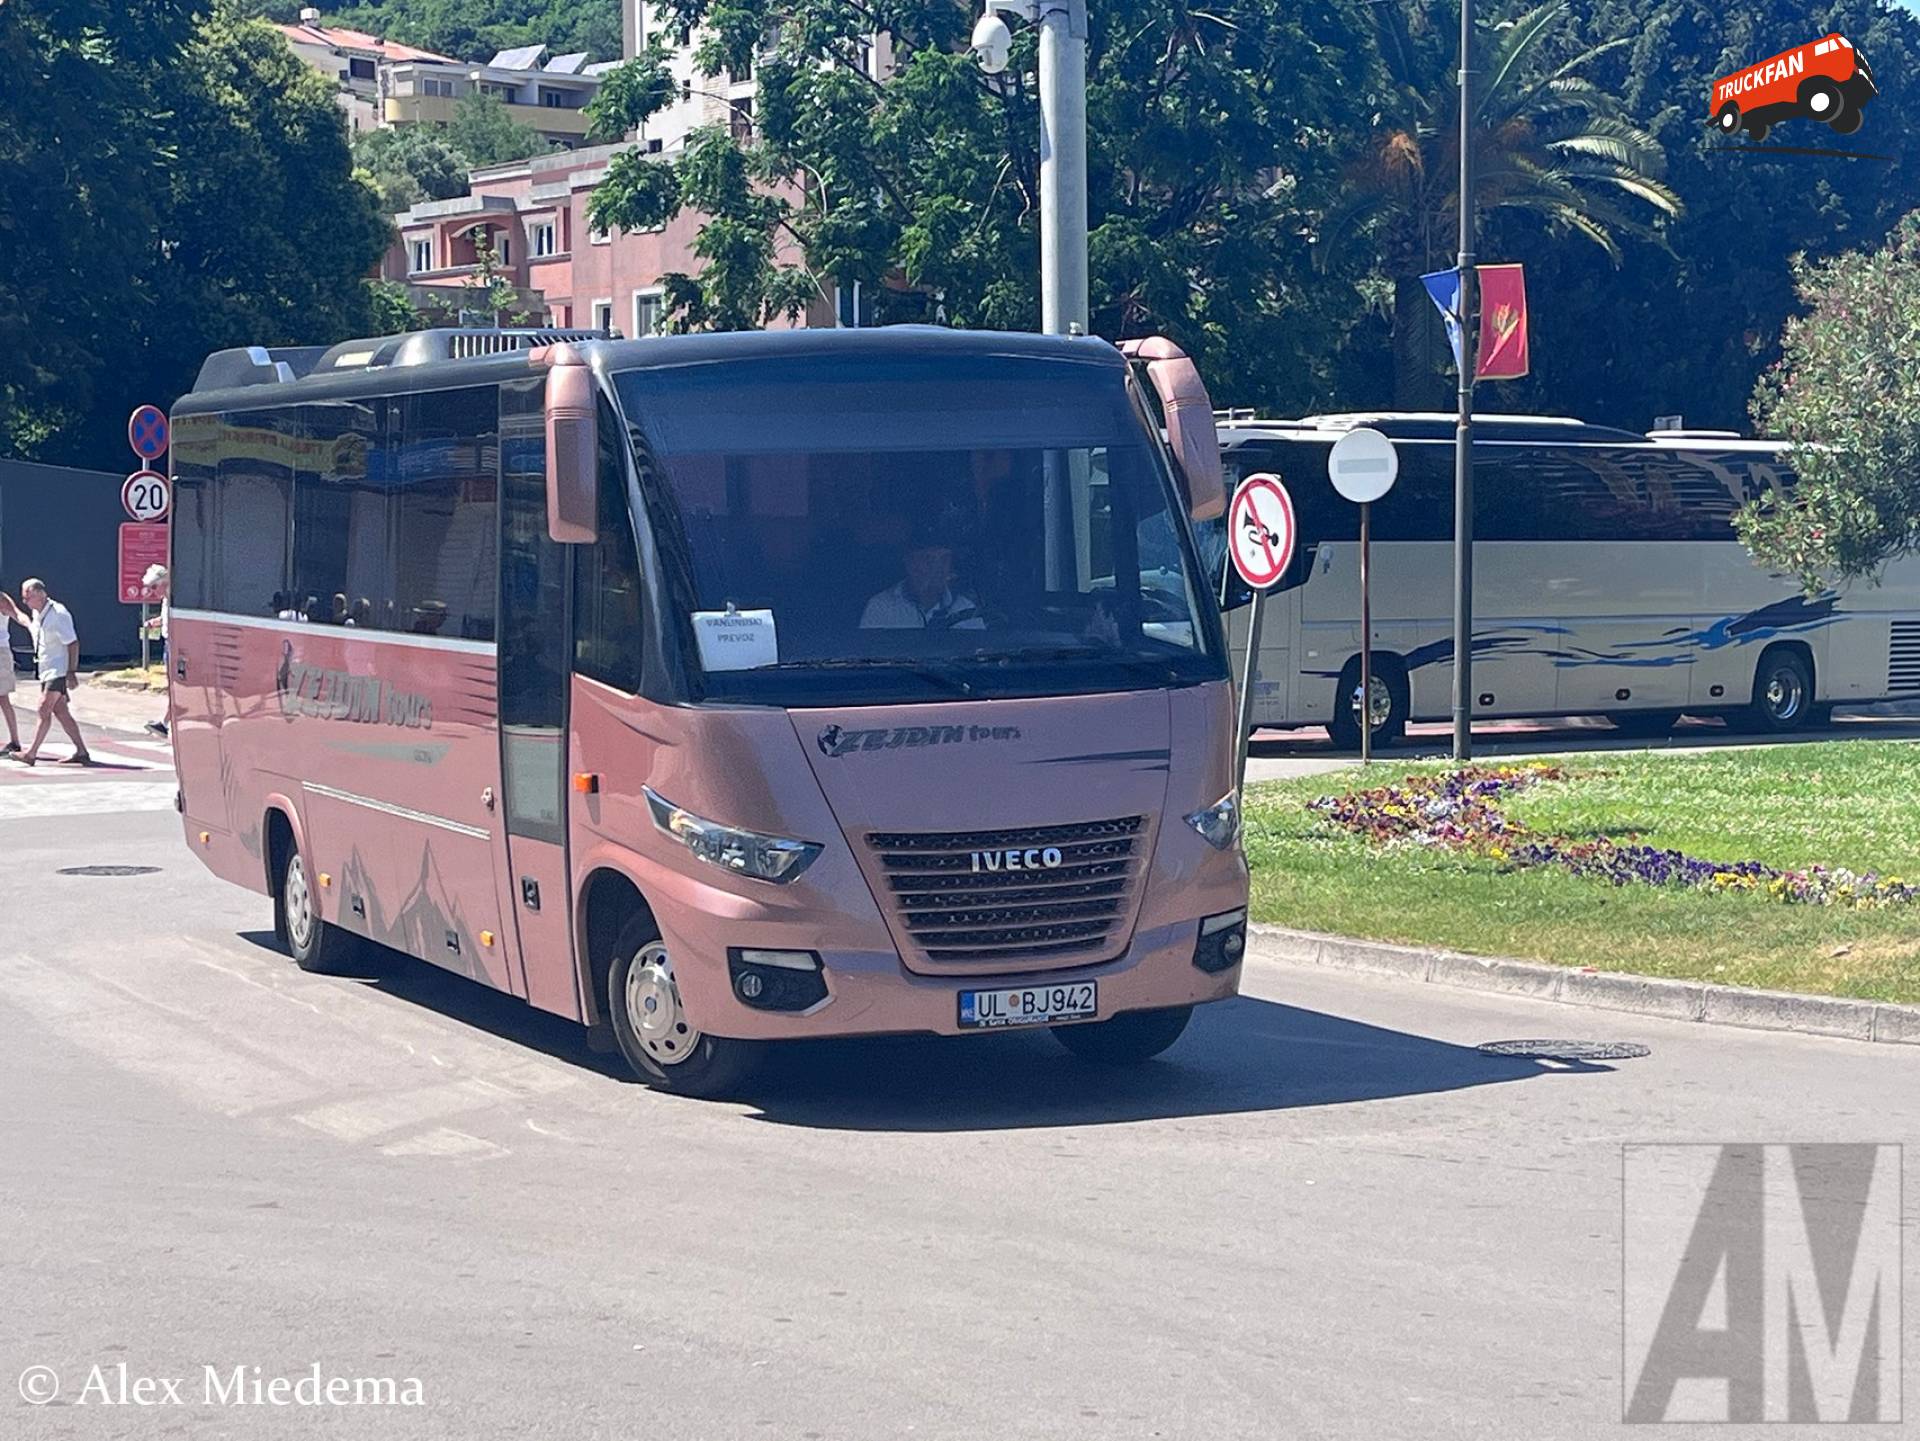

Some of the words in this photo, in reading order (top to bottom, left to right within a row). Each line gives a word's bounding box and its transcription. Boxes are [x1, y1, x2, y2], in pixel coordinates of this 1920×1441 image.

[133, 484, 163, 511] 20
[968, 724, 1022, 742] tours
[971, 847, 1062, 873] IVECO
[978, 994, 1007, 1018] UL
[1022, 986, 1093, 1014] BJ942
